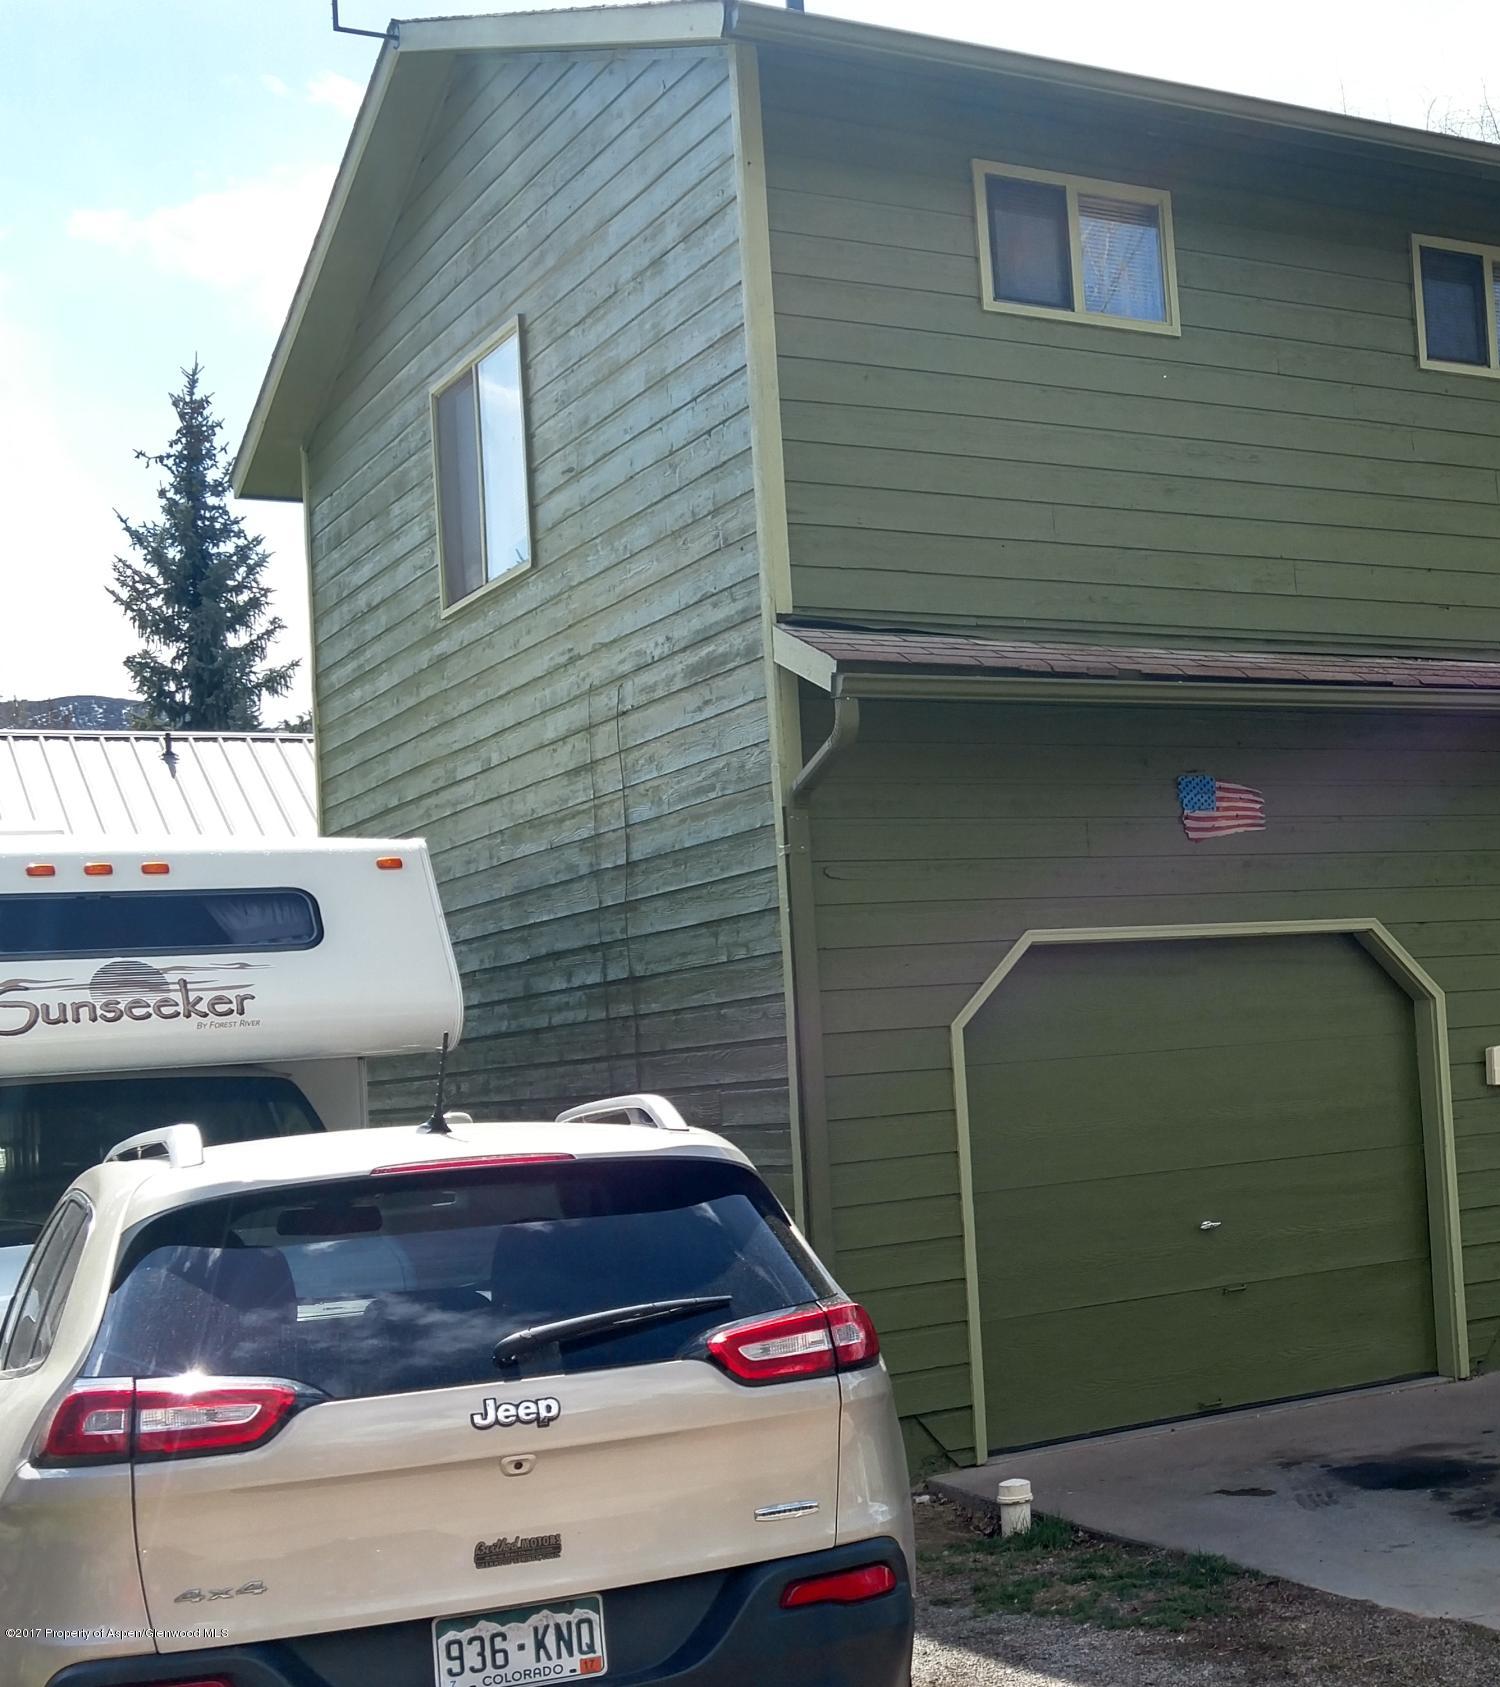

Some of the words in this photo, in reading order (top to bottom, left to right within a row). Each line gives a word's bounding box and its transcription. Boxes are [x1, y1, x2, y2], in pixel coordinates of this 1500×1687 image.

[0, 978, 256, 1036] Sunseeker
[209, 1020, 237, 1029] FOREST
[239, 1019, 261, 1027] RIVER
[470, 1397, 561, 1430] Jeep
[520, 1533, 562, 1550] MOTORS
[482, 1664, 564, 1686] COLORADO
